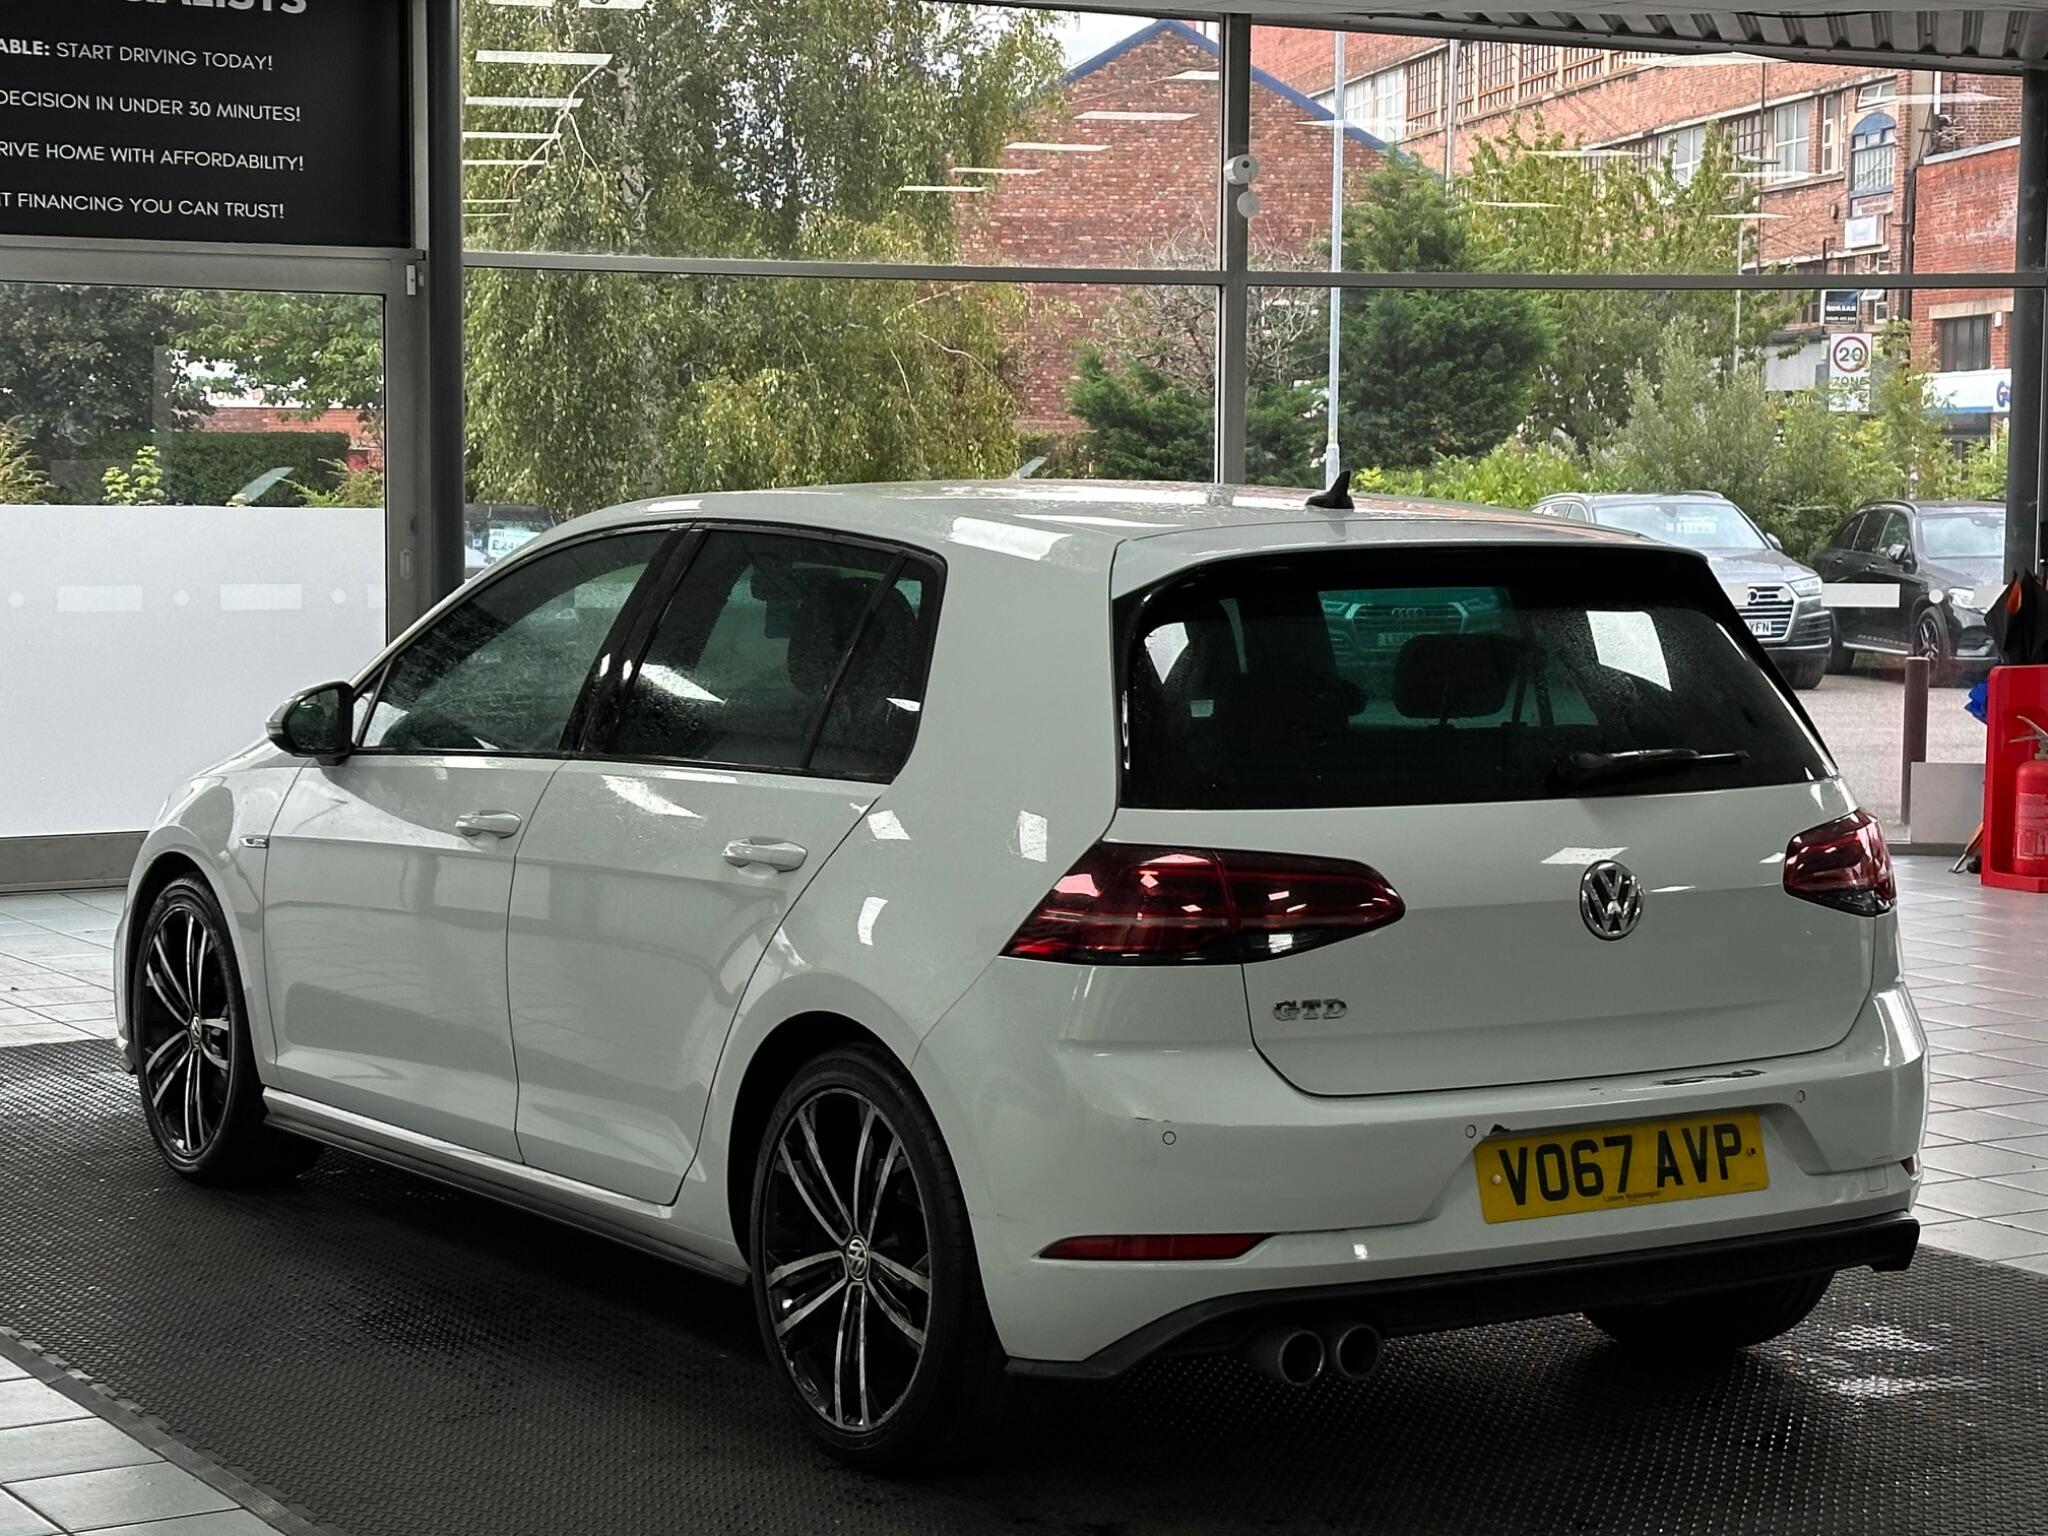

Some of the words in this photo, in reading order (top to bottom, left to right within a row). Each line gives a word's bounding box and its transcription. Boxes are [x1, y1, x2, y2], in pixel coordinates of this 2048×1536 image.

[57, 42, 113, 59] START
[120, 47, 197, 65] DRIVING
[203, 52, 273, 71] TODAY!
[0, 90, 90, 109] DECISION
[96, 95, 114, 111] IN
[120, 97, 183, 115] UNDER
[189, 101, 211, 117] 30
[217, 103, 301, 122] MINUTES!
[47, 144, 104, 161] HOME
[110, 147, 154, 164] WITH
[160, 150, 304, 171] AFFORDABILITY!
[18, 193, 123, 212] FINANCING
[129, 198, 172, 214] YOU
[178, 201, 219, 216] CAN
[224, 202, 284, 219] TRUST!
[1839, 347, 1863, 361] 20
[1833, 376, 1869, 387] ZONE
[1272, 999, 1347, 1021] GTD
[1498, 1134, 1633, 1205] VO67
[1657, 1123, 1741, 1188] AVP
